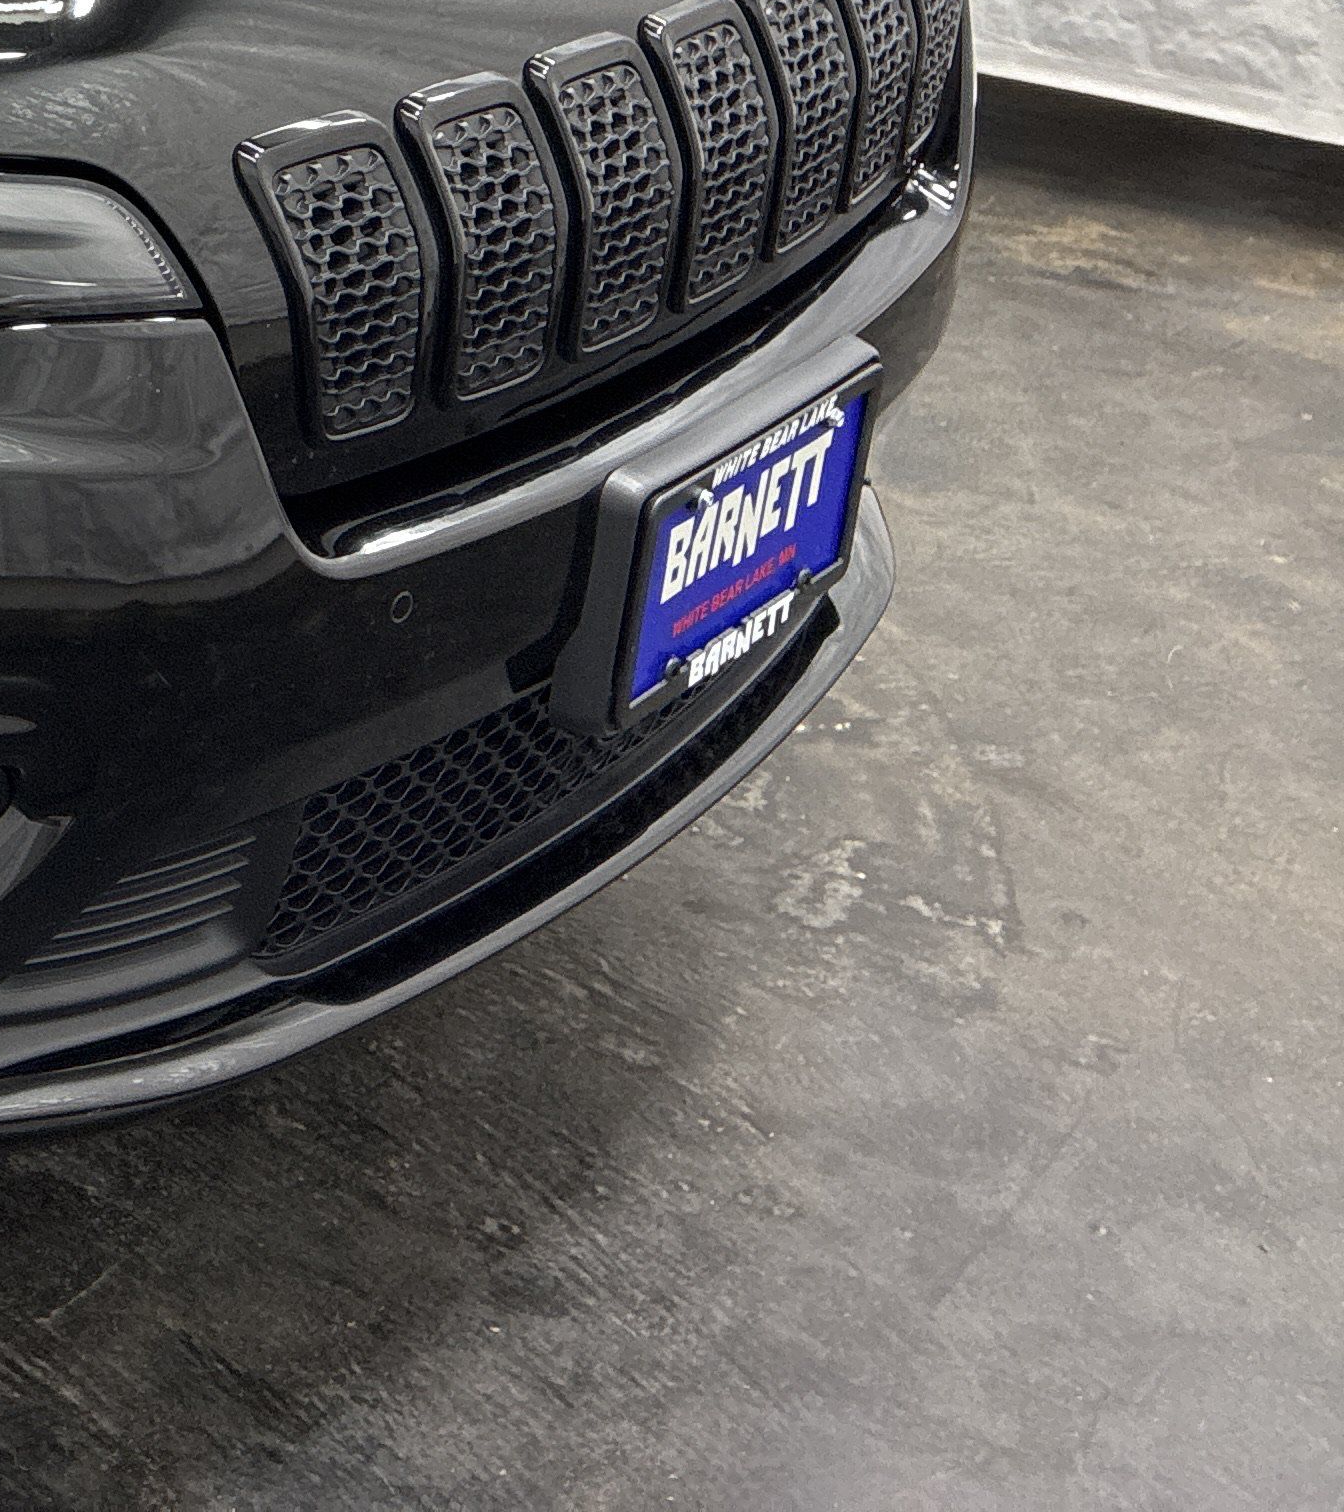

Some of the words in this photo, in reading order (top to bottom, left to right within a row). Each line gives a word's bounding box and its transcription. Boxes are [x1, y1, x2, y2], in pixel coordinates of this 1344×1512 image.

[712, 443, 760, 488] WHITE
[760, 419, 800, 460] BEAR
[798, 393, 839, 435] LAKE
[660, 428, 835, 605] BARNETT
[672, 599, 711, 638] WHITE
[709, 578, 746, 612] BEAR
[688, 591, 795, 688] BARNETT
